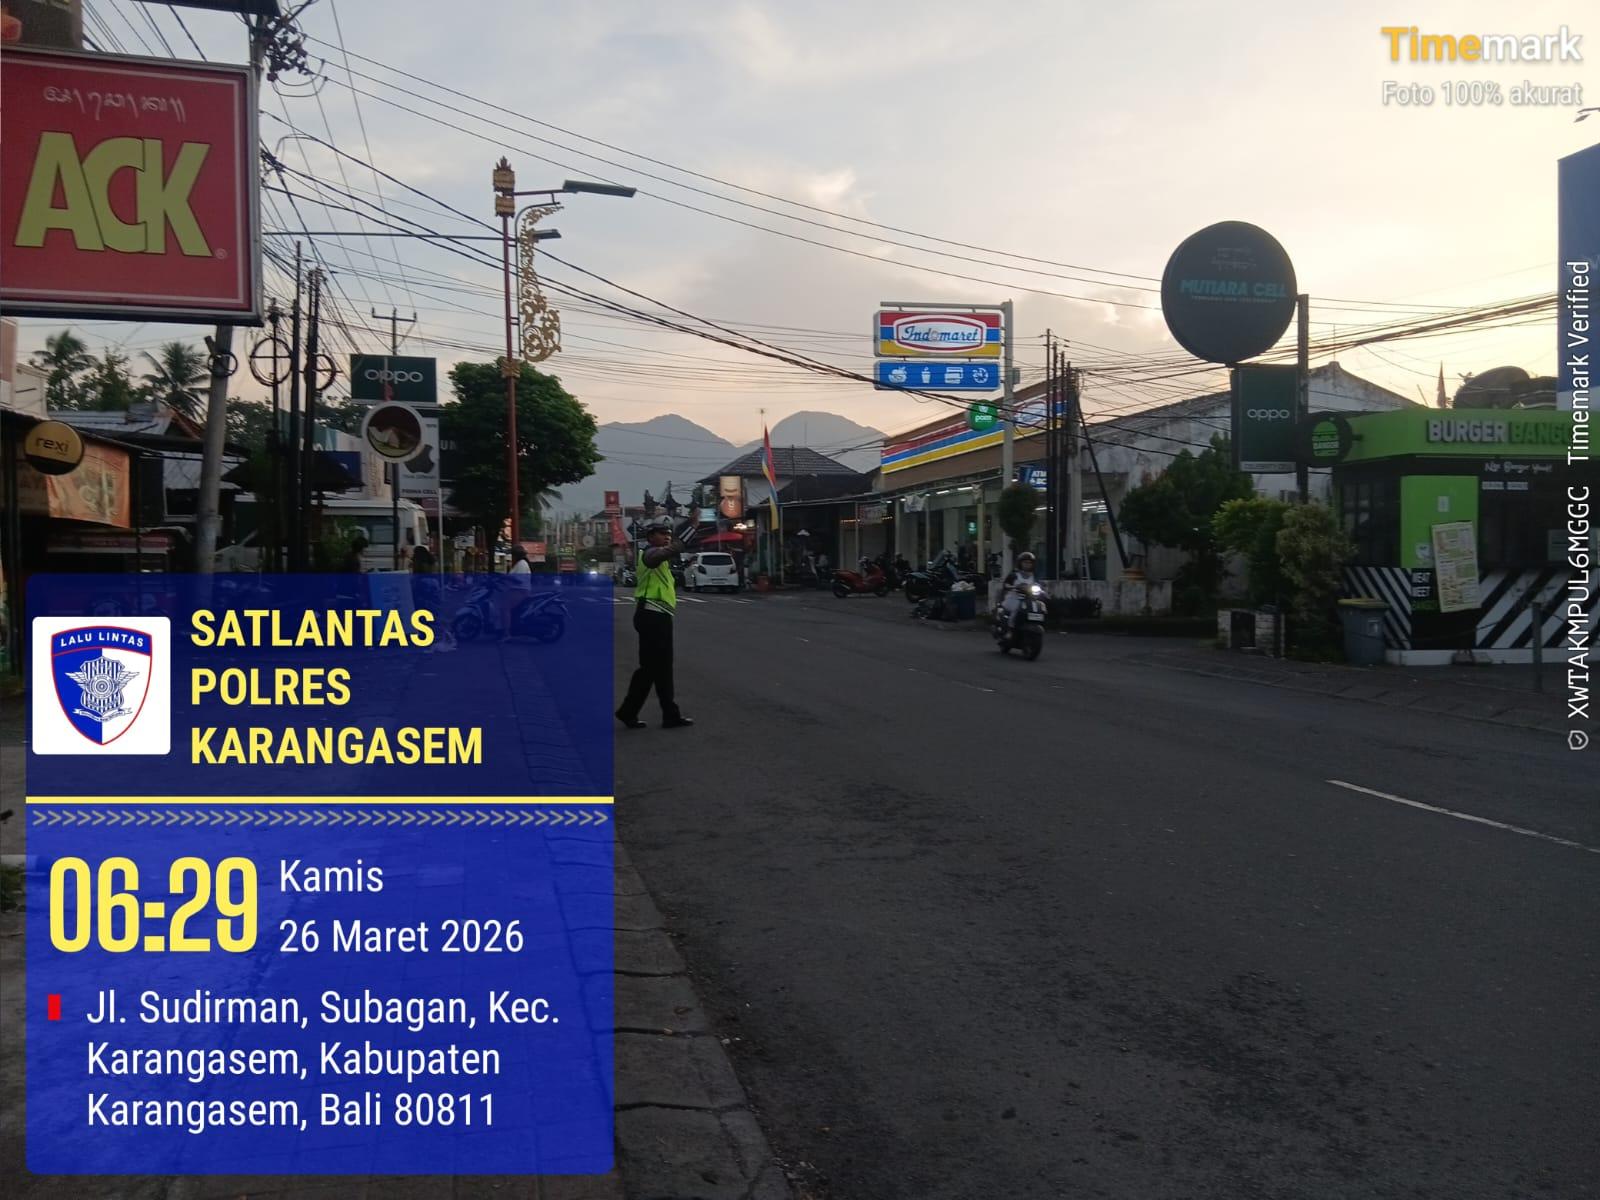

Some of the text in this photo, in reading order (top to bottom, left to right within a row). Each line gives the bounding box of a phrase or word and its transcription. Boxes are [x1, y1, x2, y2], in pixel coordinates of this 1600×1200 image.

[13, 130, 213, 257] ACK
[1180, 279, 1248, 296] MUTIARA
[901, 326, 979, 341] Indomaret
[1428, 419, 1508, 442] BURGER
[35, 437, 70, 453] rexi
